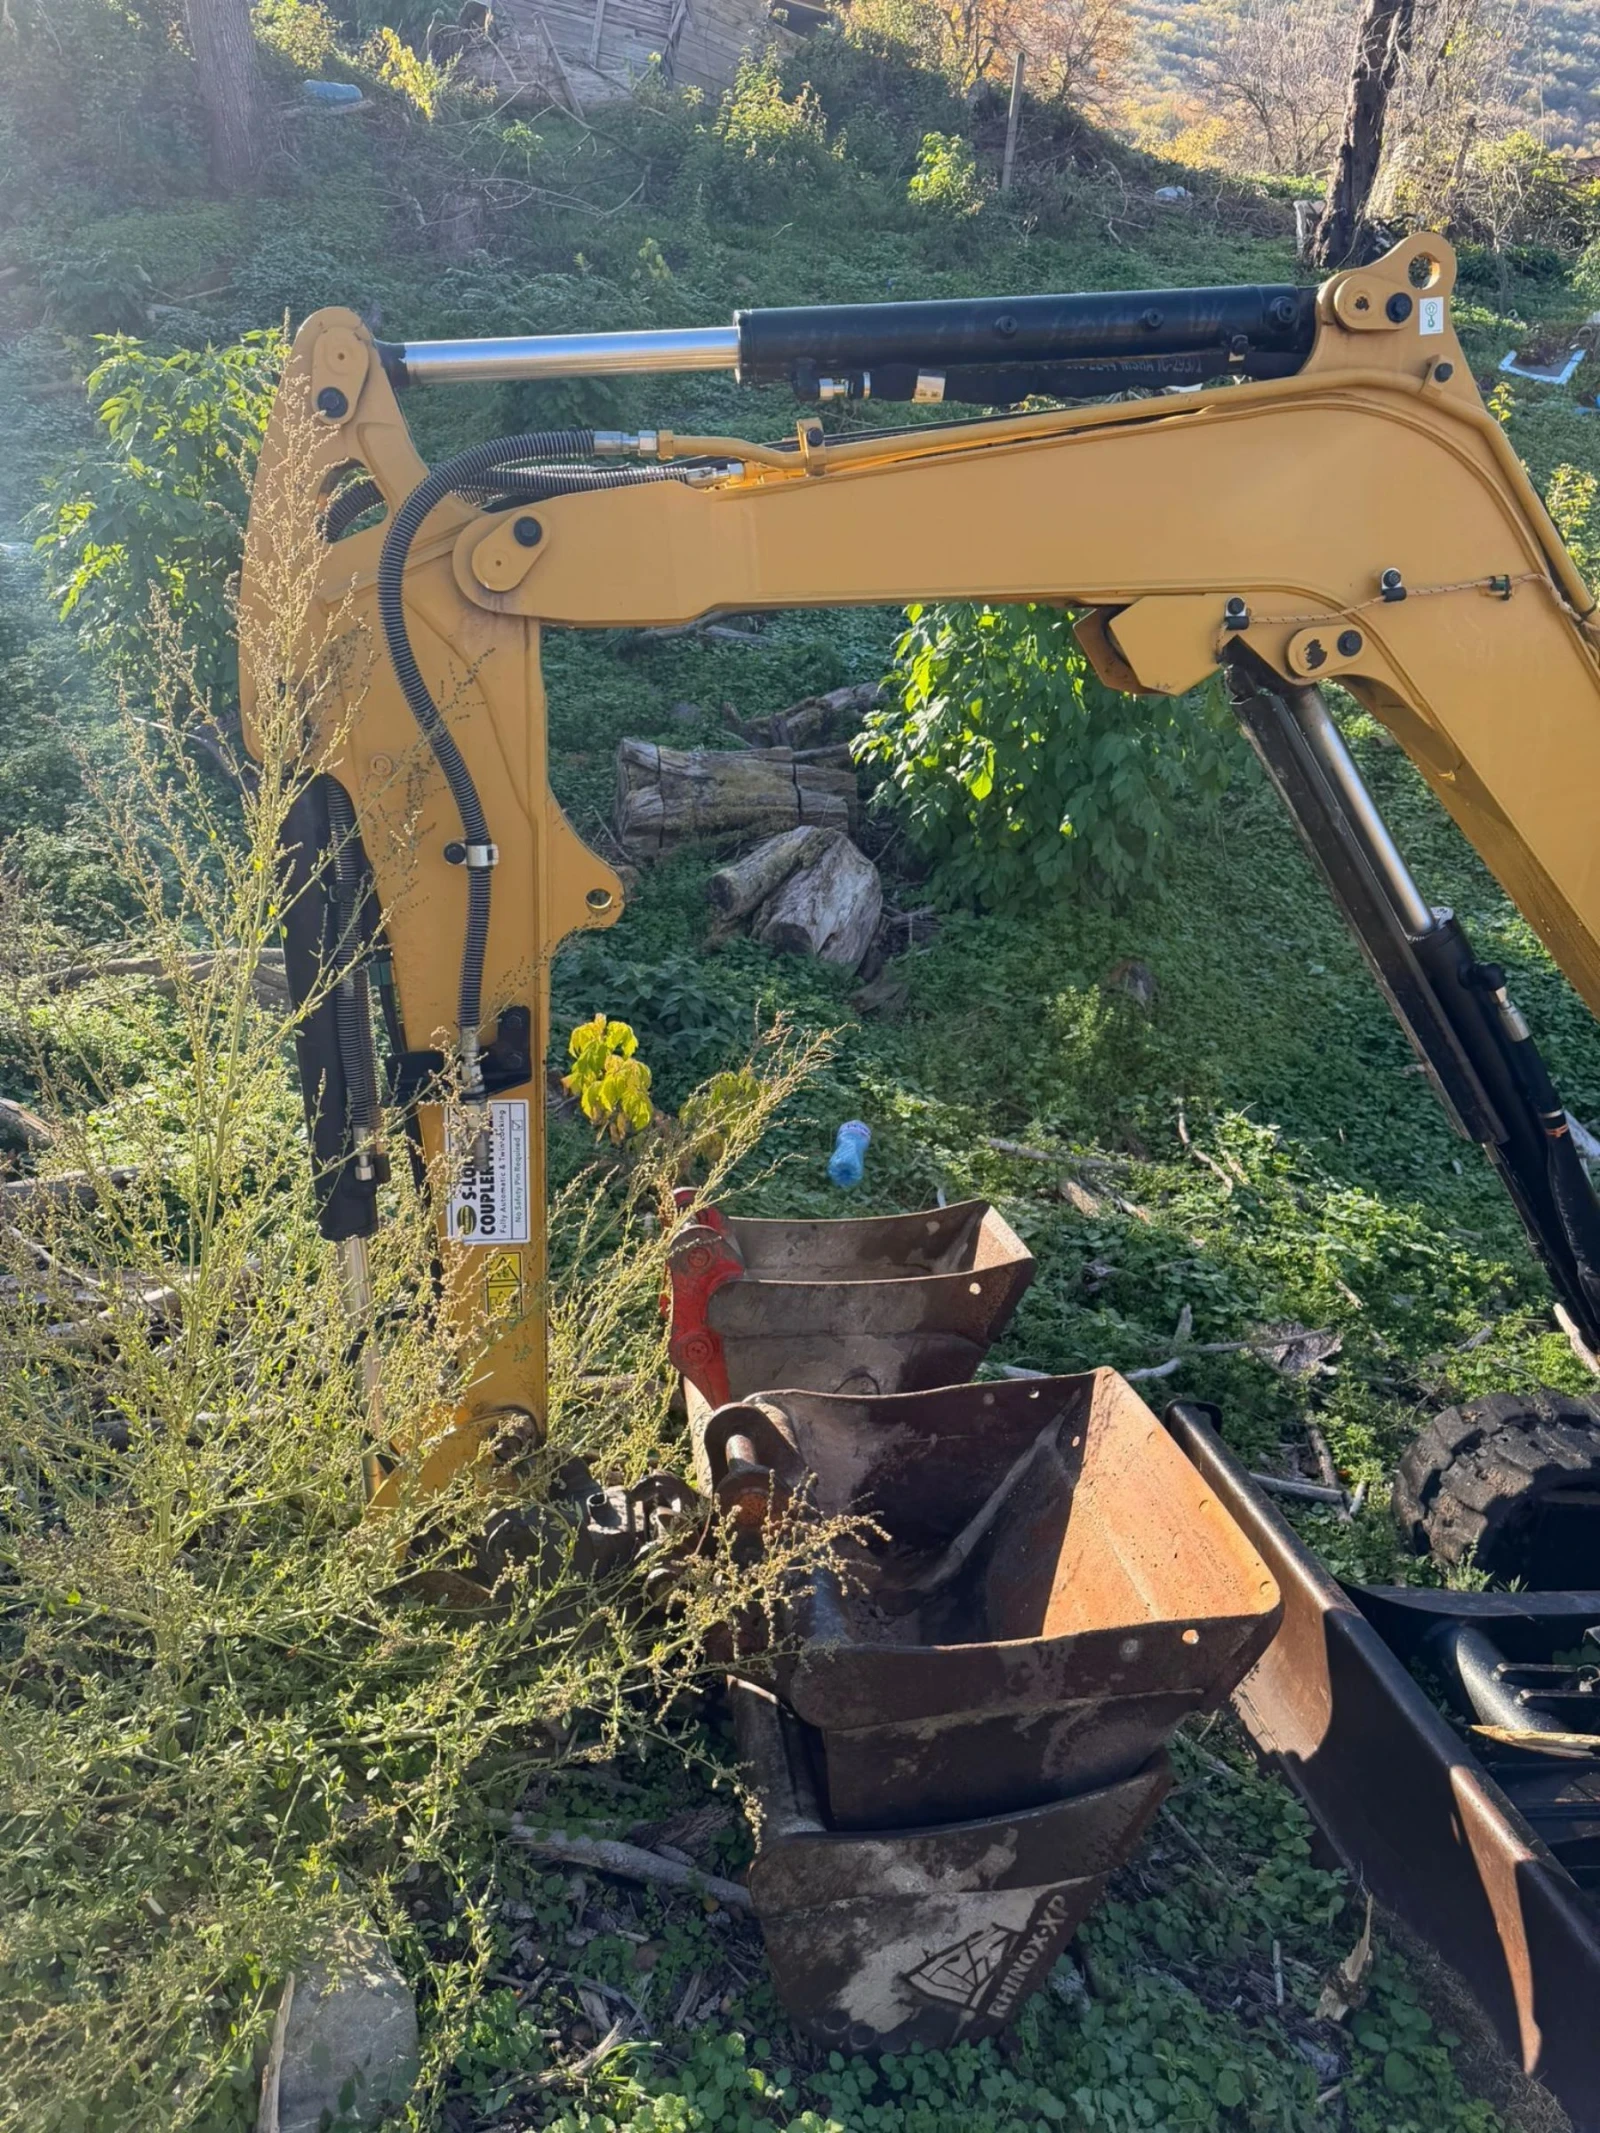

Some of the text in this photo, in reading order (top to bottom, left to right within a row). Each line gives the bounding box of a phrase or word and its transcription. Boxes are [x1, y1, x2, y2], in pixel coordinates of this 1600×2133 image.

[500, 1214, 508, 1234] Fully
[513, 1137, 523, 1224] No Safety Pin Required
[986, 1895, 1070, 2019] RHINOX-XP
